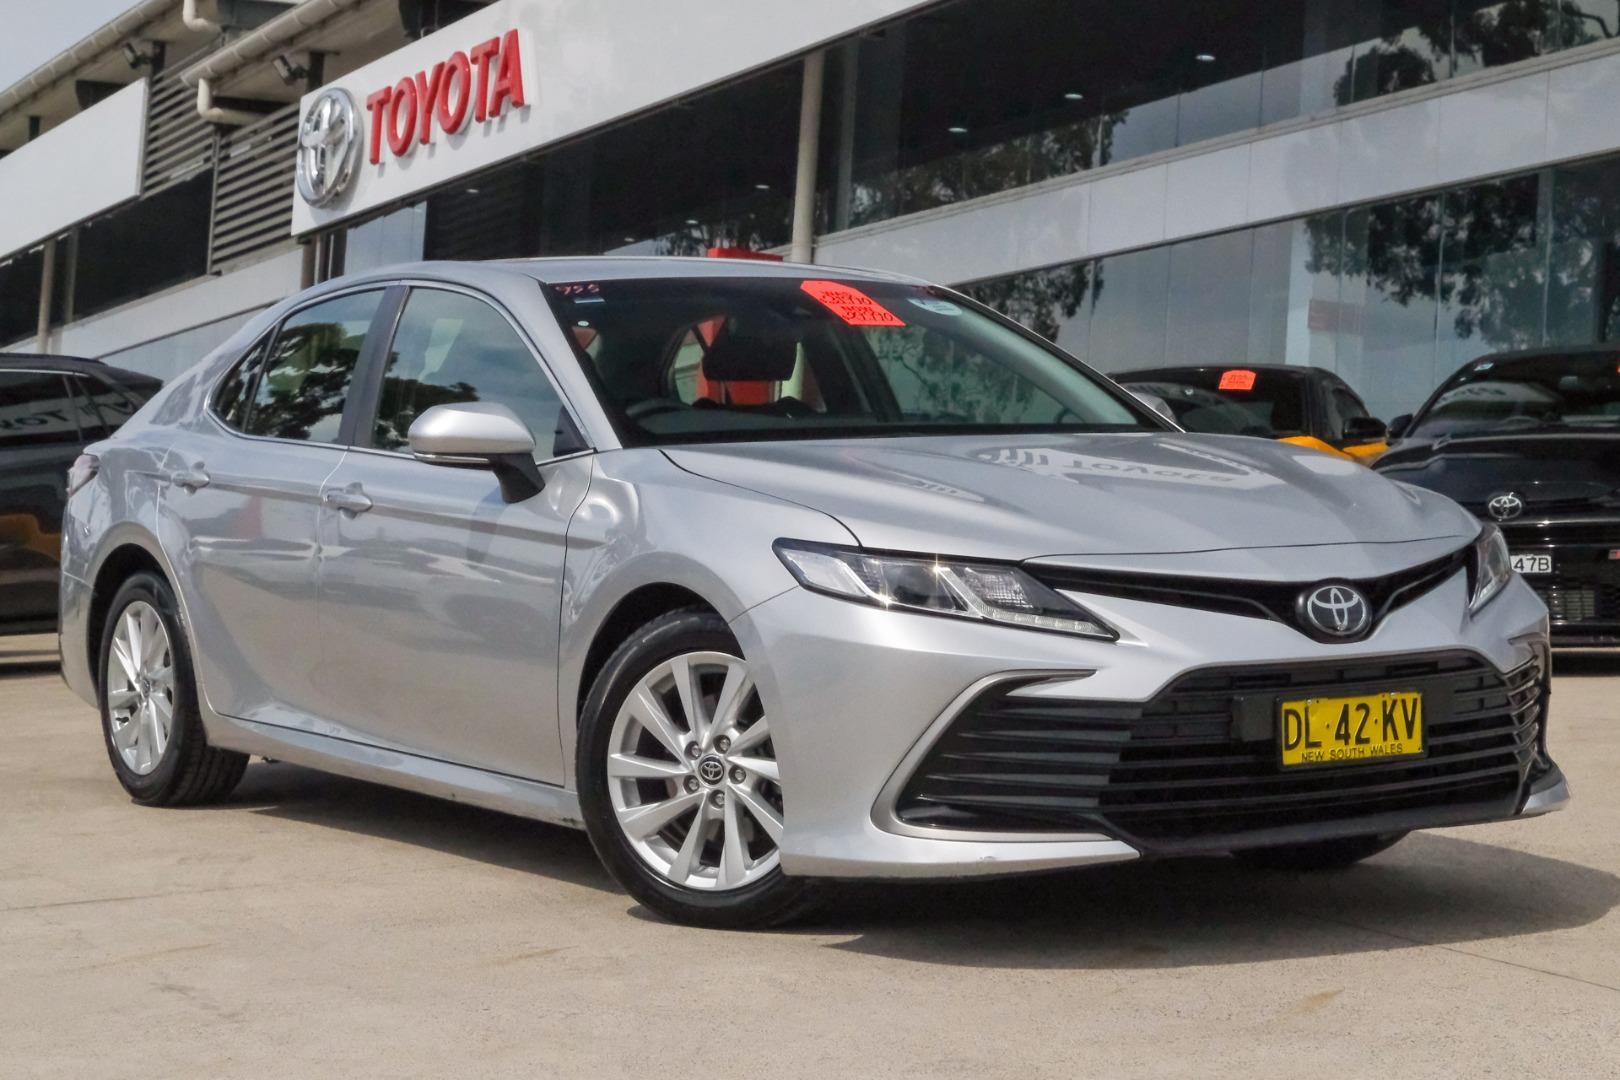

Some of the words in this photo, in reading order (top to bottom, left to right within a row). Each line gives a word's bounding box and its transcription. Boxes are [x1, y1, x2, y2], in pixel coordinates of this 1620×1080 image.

[366, 28, 525, 165] TOYOTA
[1513, 557, 1550, 572] 47B
[1301, 751, 1324, 762] NEW
[1330, 747, 1365, 760] SOUTH
[1370, 743, 1403, 756] WALES
